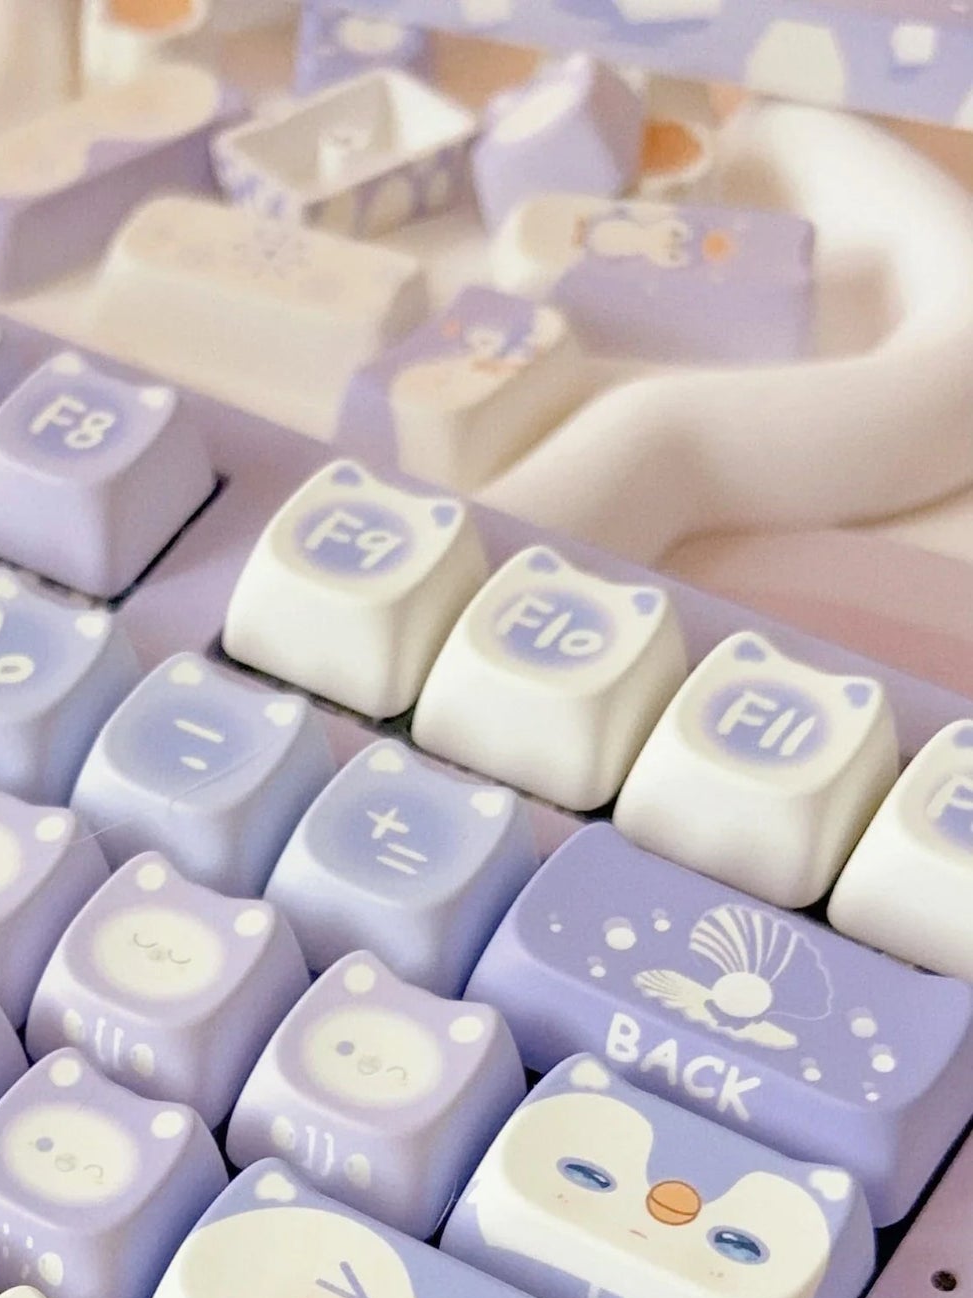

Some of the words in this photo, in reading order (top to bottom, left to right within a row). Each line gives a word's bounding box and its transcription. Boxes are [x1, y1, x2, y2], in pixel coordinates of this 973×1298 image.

[30, 396, 116, 449] F8
[304, 511, 402, 569] F9
[496, 593, 604, 657] F10
[717, 690, 815, 757] F11
[605, 1011, 763, 1124] BACK
